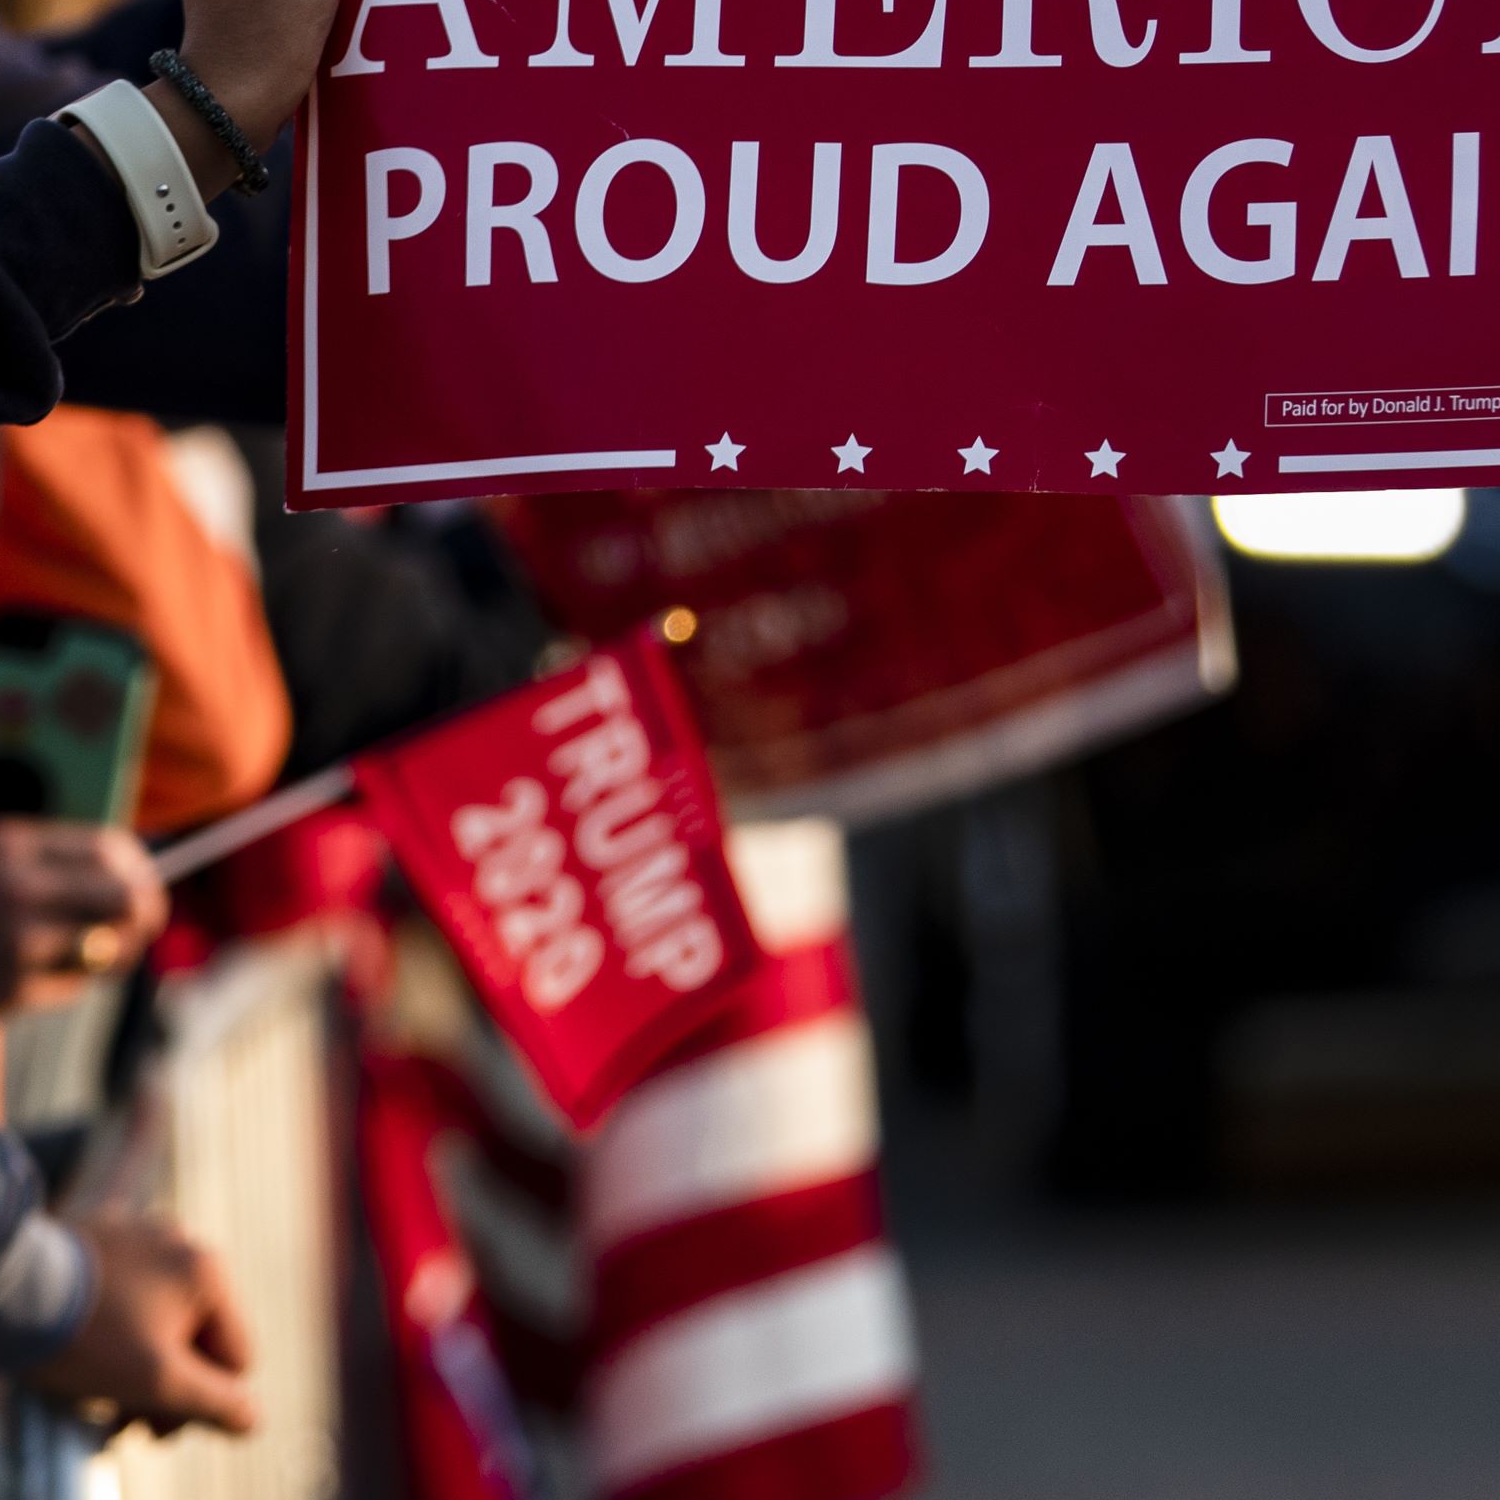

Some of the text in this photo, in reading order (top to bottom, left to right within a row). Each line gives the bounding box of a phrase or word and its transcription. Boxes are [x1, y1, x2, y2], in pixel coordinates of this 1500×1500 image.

[366, 138, 990, 295] PROUD
[1282, 399, 1317, 417] Paid
[1320, 398, 1345, 415] for
[1349, 398, 1369, 418] by
[1373, 395, 1430, 414] Donald
[1433, 396, 1445, 412] J.
[450, 776, 606, 1016] 2020
[532, 655, 724, 991] TRUMP
